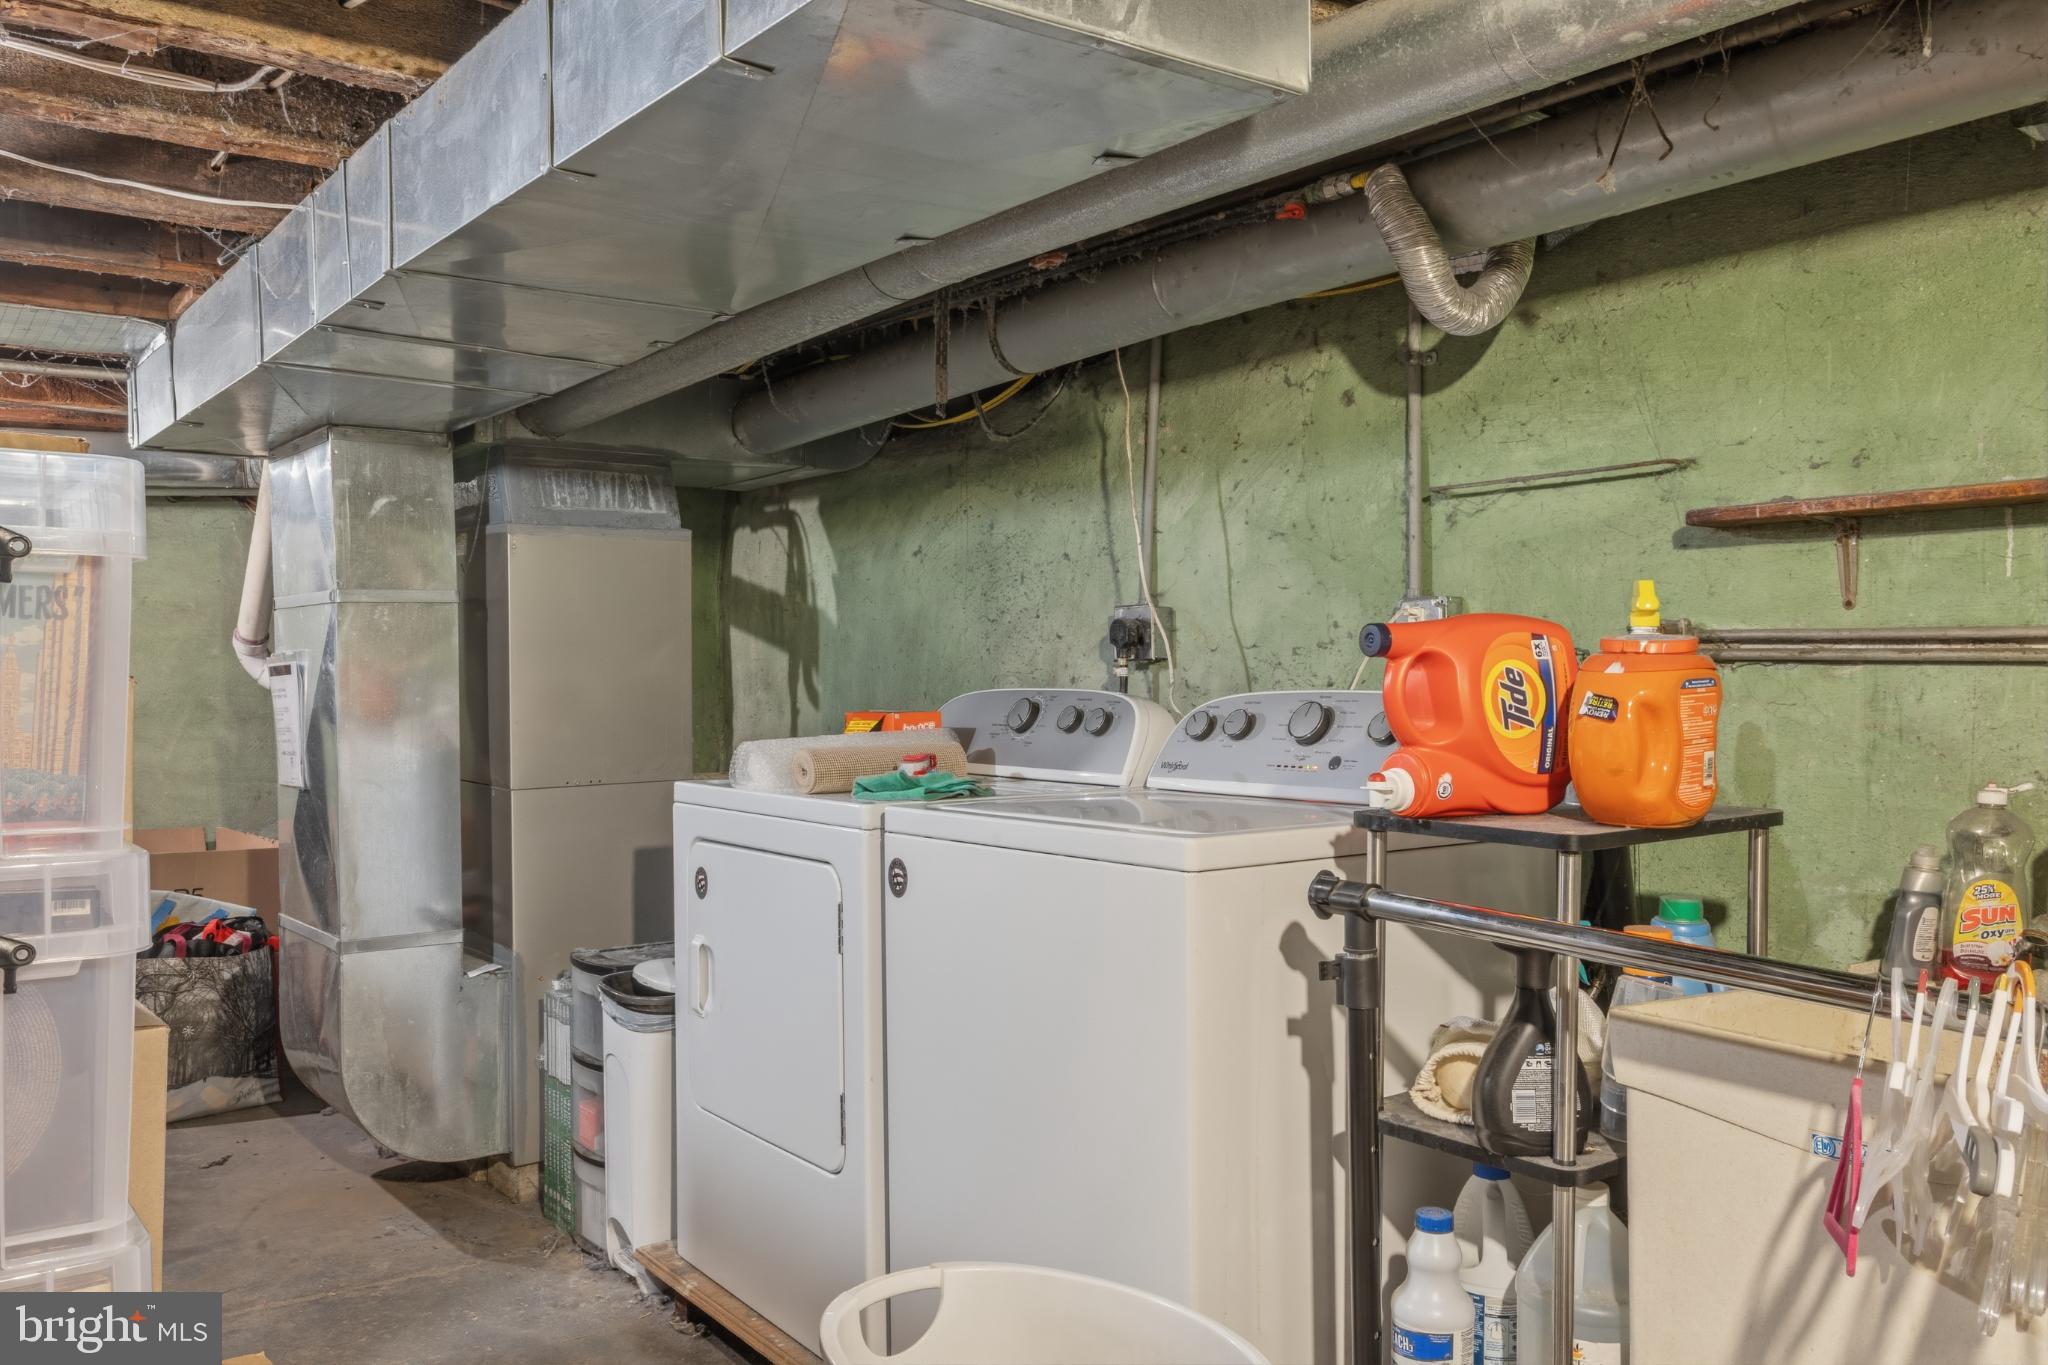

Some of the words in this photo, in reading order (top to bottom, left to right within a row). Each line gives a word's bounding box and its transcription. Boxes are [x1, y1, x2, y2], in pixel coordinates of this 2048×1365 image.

[1498, 665, 1537, 732] Tide
[1544, 725, 1554, 770] ORIGINAL
[1160, 760, 1190, 773] Whirlpool
[1976, 892, 2001, 900] MORE
[1959, 905, 2017, 934] SUN
